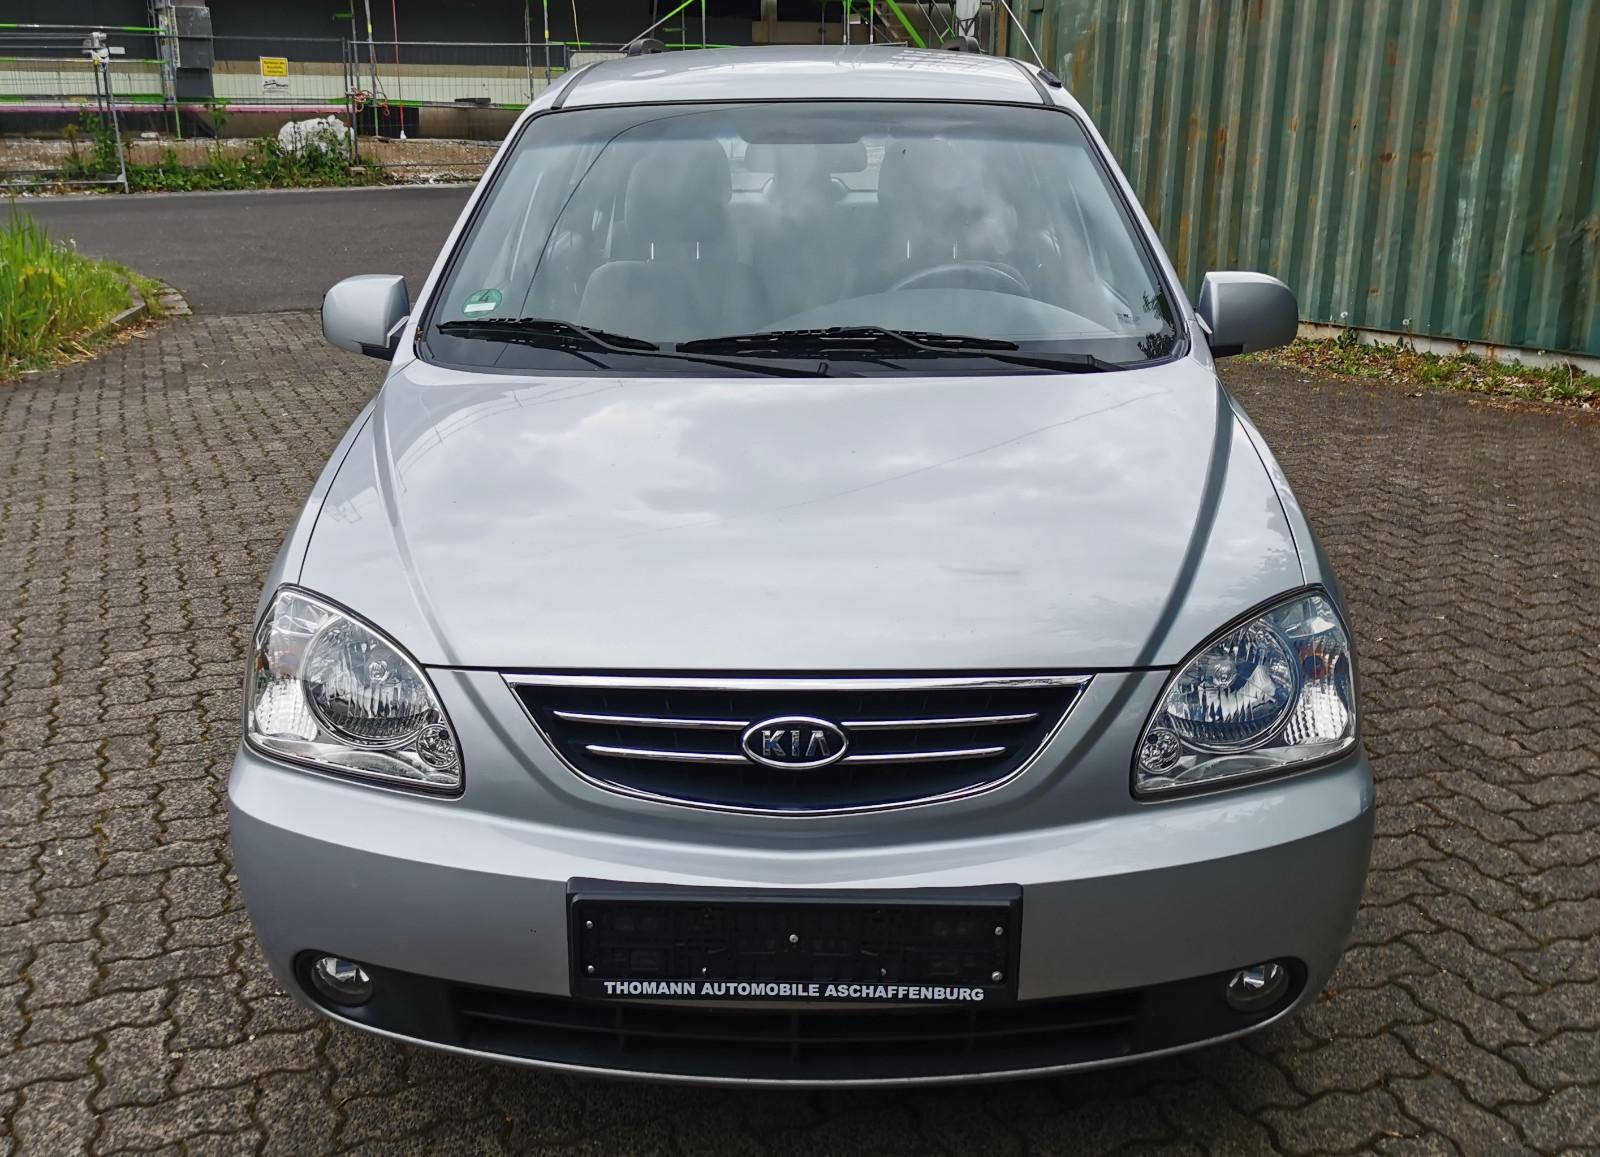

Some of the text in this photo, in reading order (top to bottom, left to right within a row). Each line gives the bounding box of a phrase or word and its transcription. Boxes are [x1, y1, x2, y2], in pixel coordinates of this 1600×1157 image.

[478, 289, 490, 303] 4
[761, 730, 831, 757] KIA
[604, 981, 985, 1001] THOMANN AUTOMOBILE ASCHAFFENBURG
